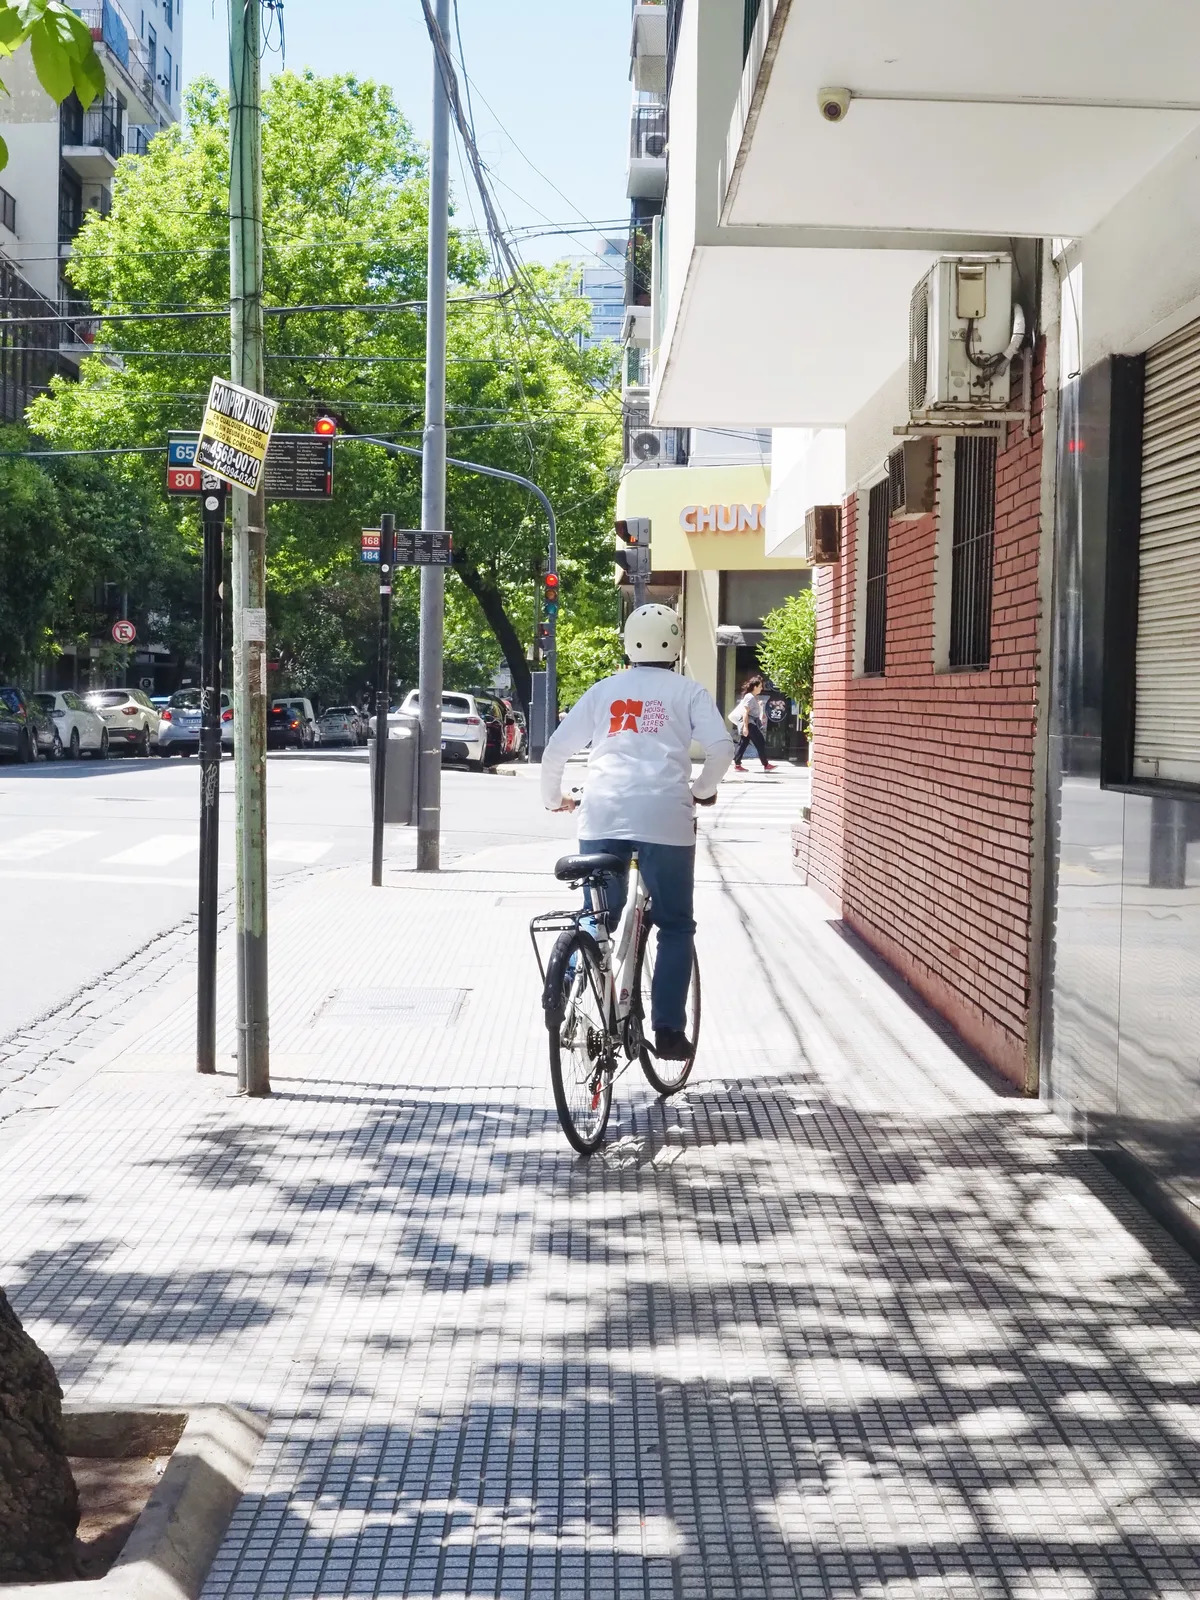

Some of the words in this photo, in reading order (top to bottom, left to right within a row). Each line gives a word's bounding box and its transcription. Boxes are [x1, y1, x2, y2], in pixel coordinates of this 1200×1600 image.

[211, 384, 246, 420] COMPRO
[243, 399, 273, 433] AUTOS
[220, 416, 244, 432] CUALQUIER
[245, 427, 262, 441] ESTADO
[175, 445, 195, 460] 65
[232, 438, 255, 454] CONTADO
[210, 440, 261, 478] 4568-0070
[175, 473, 195, 487] 80
[679, 503, 766, 533] CHUN
[363, 536, 379, 545] 168
[362, 551, 379, 560] 184
[643, 713, 670, 721] BUENOS
[644, 706, 666, 714] HOUSE
[640, 726, 658, 734] 2024
[641, 720, 664, 728] AIRES
